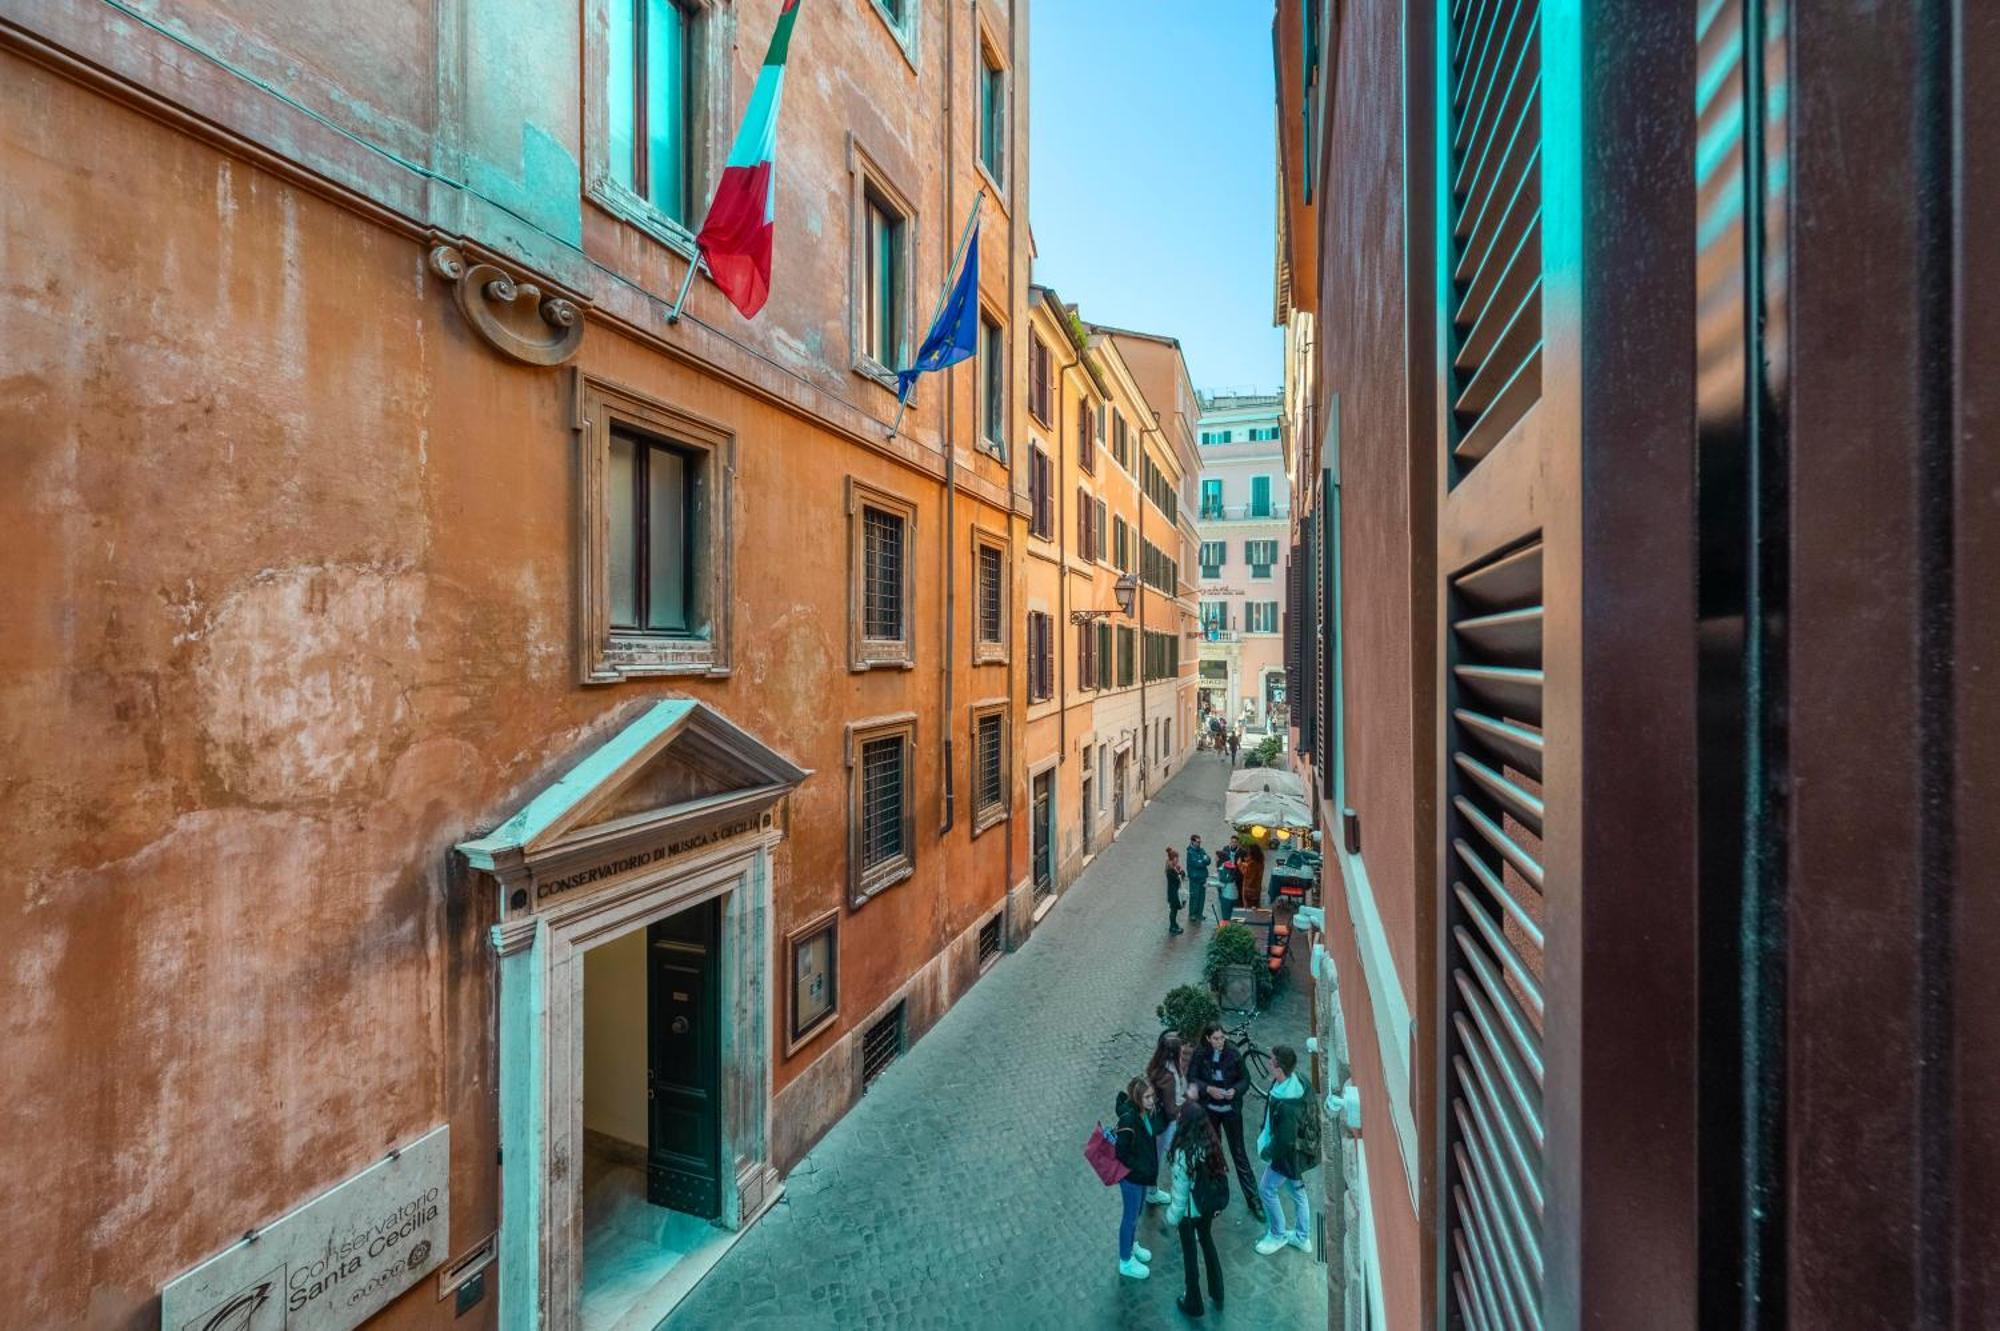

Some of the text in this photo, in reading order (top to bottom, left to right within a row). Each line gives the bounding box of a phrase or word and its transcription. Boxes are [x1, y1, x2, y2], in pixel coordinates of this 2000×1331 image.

[537, 850, 650, 899] CONSERVATORIO
[653, 846, 666, 863] DI
[668, 835, 708, 858] MUSICA
[721, 817, 760, 839] CECILIA
[289, 1187, 438, 1290] Conservatorio
[289, 1256, 361, 1312] Santa
[368, 1205, 438, 1258] Cecilia
